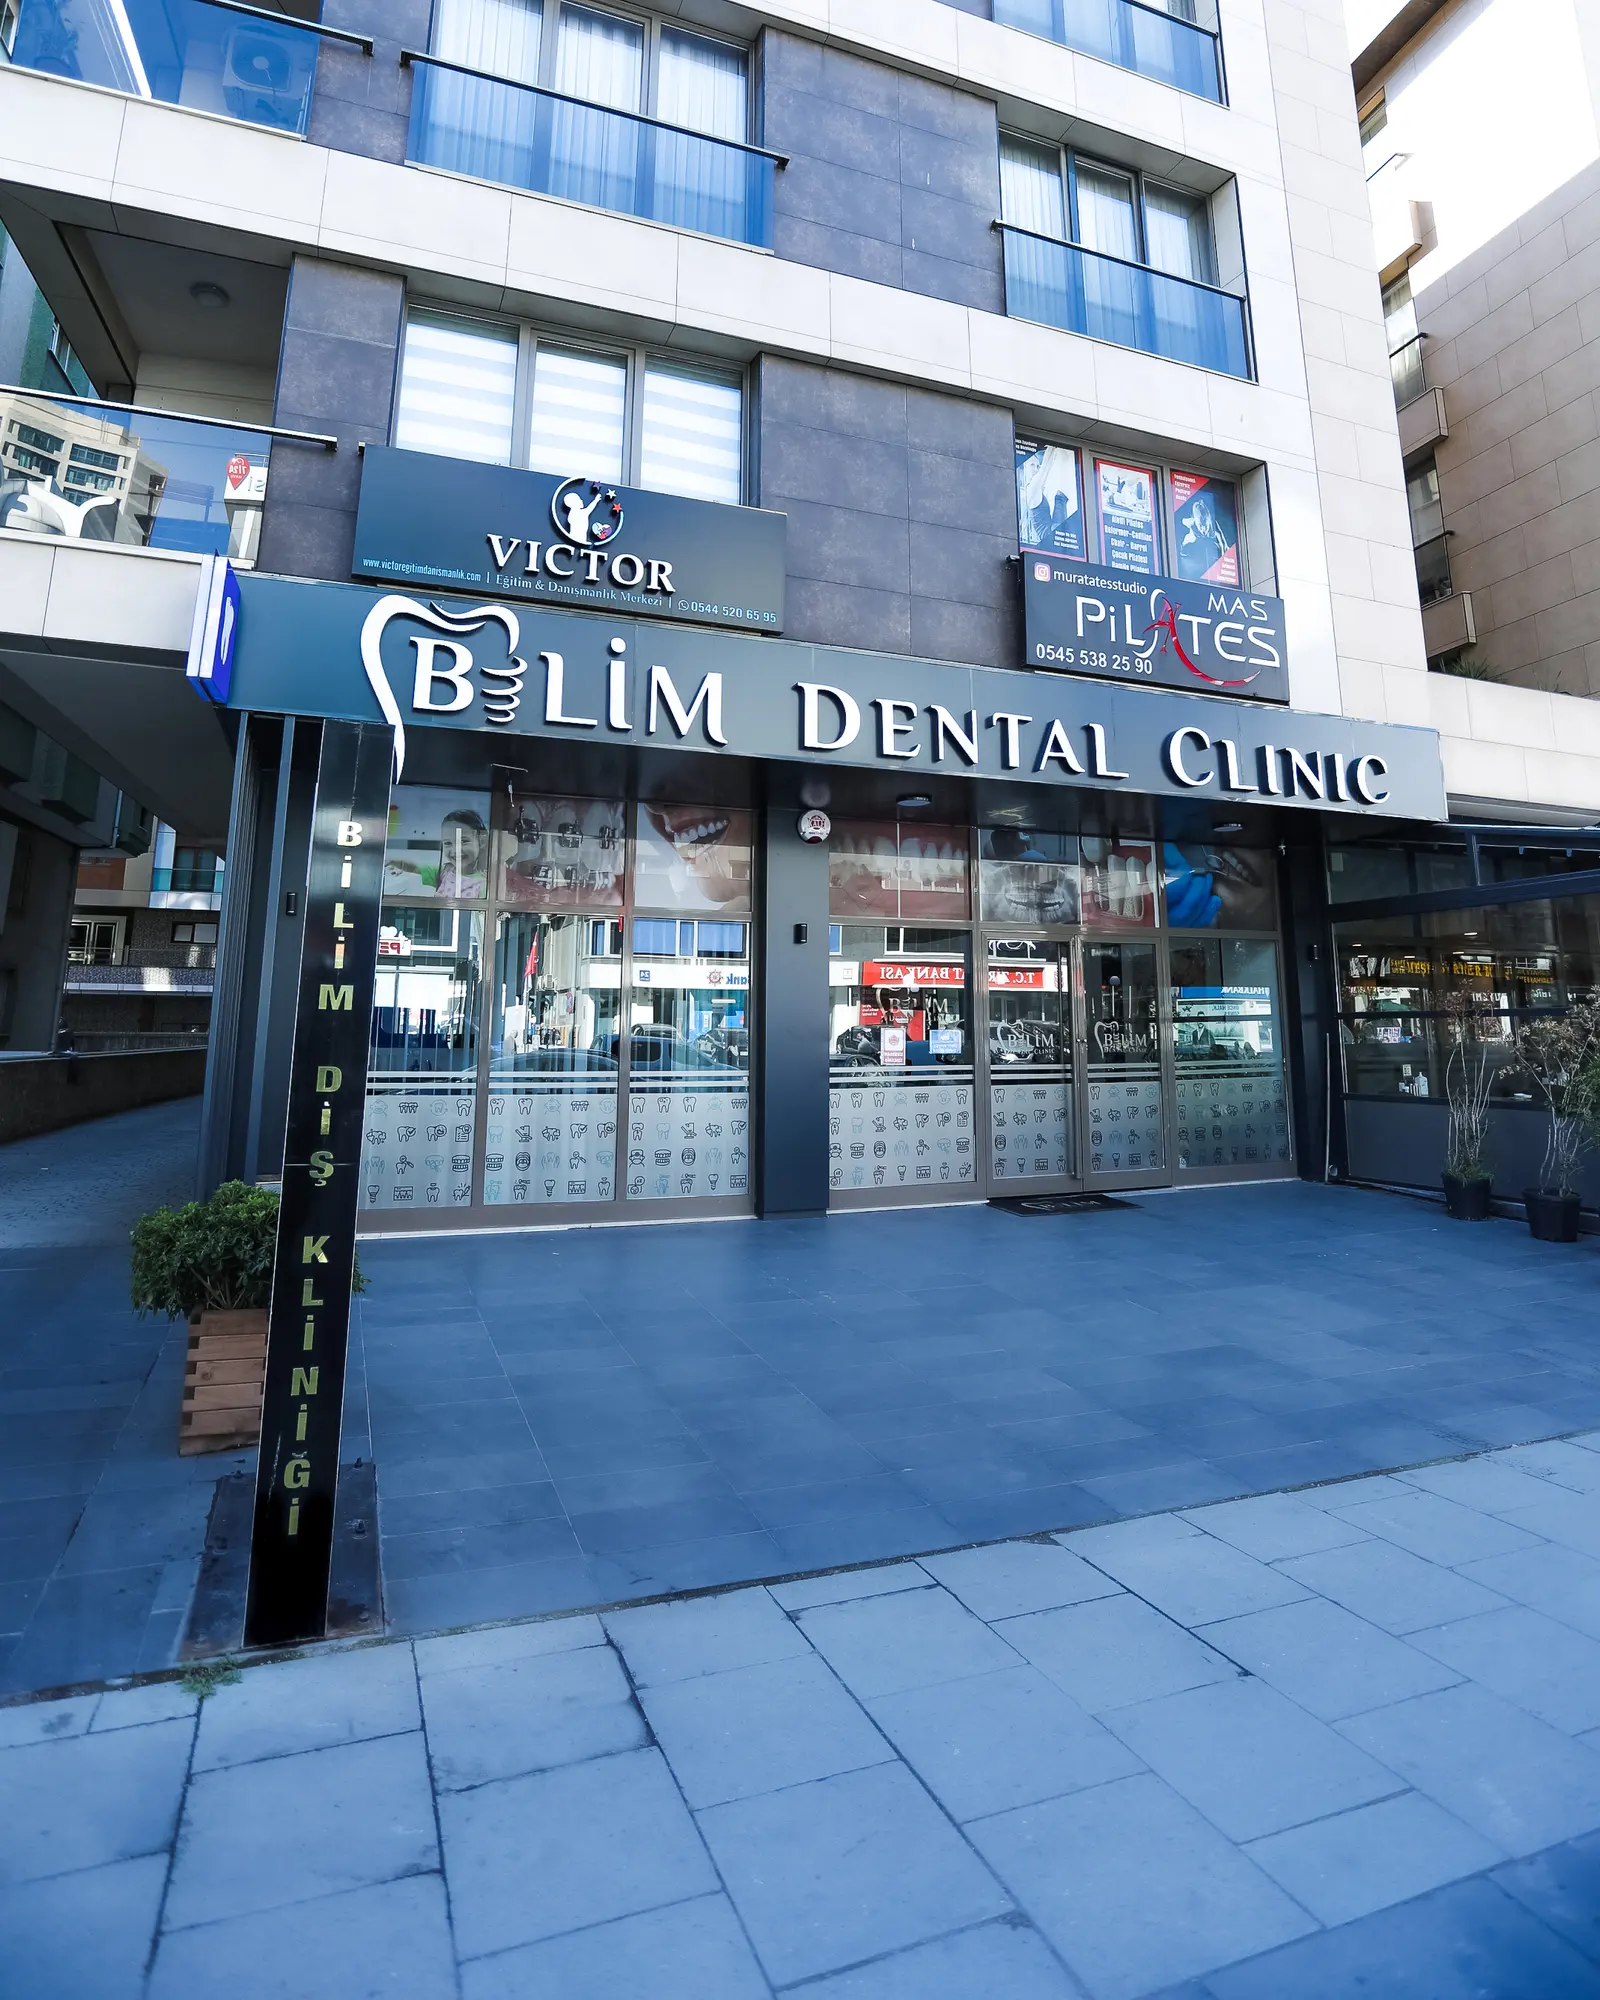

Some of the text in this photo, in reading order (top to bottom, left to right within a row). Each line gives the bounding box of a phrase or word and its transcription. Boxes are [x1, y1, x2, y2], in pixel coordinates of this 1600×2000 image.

[487, 534, 676, 592] VICTOR
[496, 574, 663, 606] Eğitim & Danışmanlık Merkezi
[1053, 568, 1148, 595] muratatesstudio
[691, 601, 777, 623] 0544 520 65 95
[1208, 592, 1268, 621] MAS
[1036, 643, 1153, 675] 0545 538 25 90
[797, 682, 1129, 779] DENTAL
[1167, 726, 1392, 805] CLINIC
[283, 819, 363, 1536] BİLİM DİŞ KLİNİĞİ
